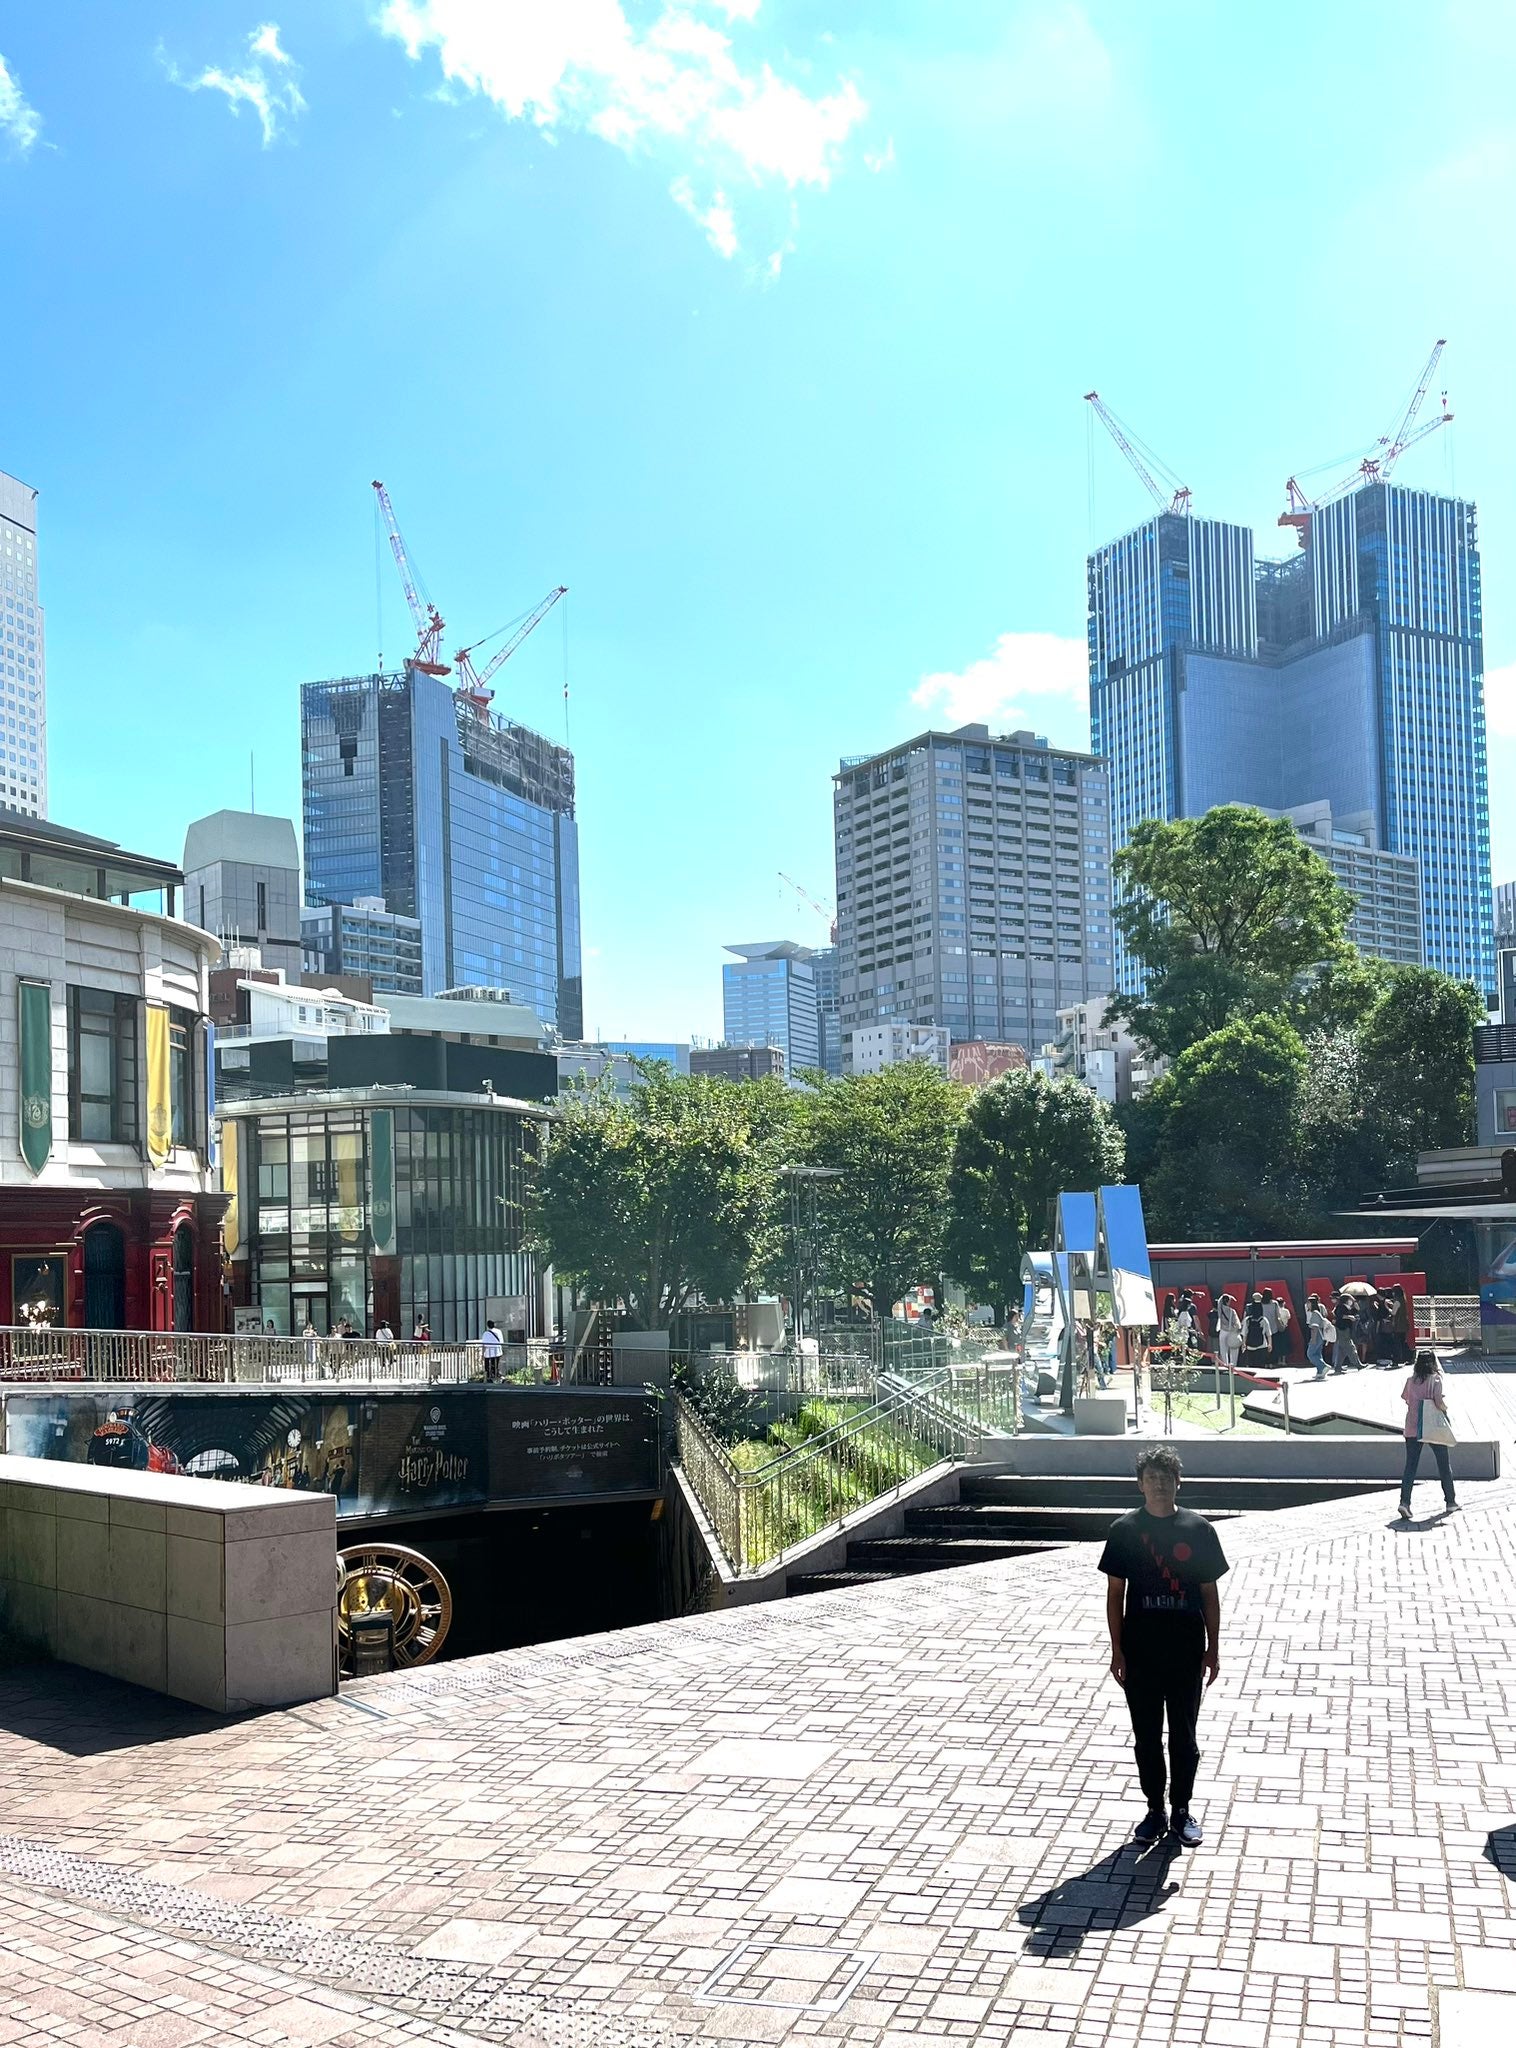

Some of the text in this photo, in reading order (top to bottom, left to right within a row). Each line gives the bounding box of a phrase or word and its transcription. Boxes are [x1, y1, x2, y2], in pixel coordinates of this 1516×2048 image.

[544, 1425, 604, 1437] こうして生まれた
[398, 1449, 468, 1487] Harry Potter
